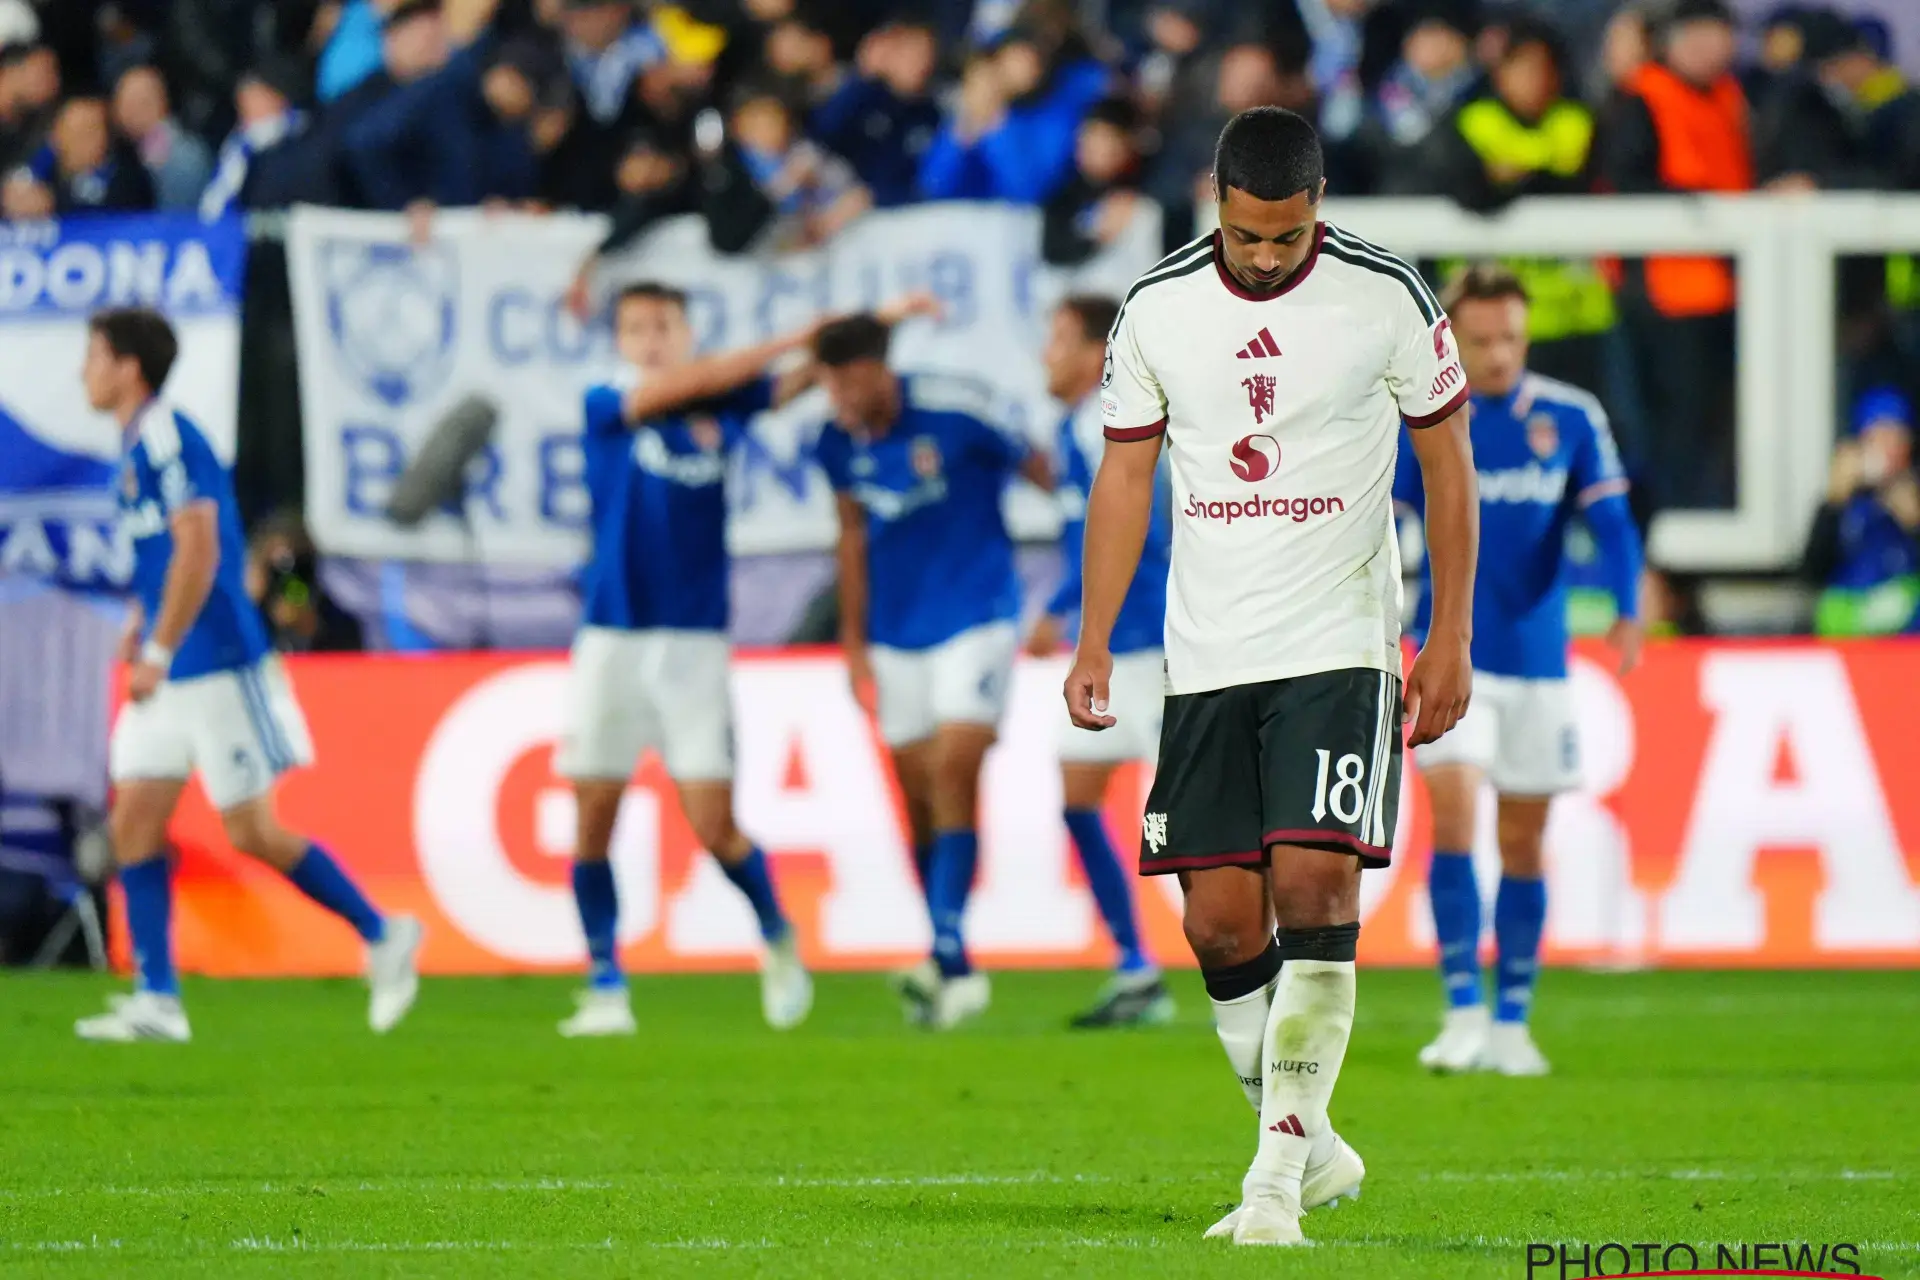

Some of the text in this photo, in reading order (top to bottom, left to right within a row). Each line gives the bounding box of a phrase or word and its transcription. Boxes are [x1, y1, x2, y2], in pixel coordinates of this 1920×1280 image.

[1184, 493, 1345, 525] Snapdragon
[1311, 748, 1365, 824] 18
[1271, 1060, 1319, 1075] MUFC
